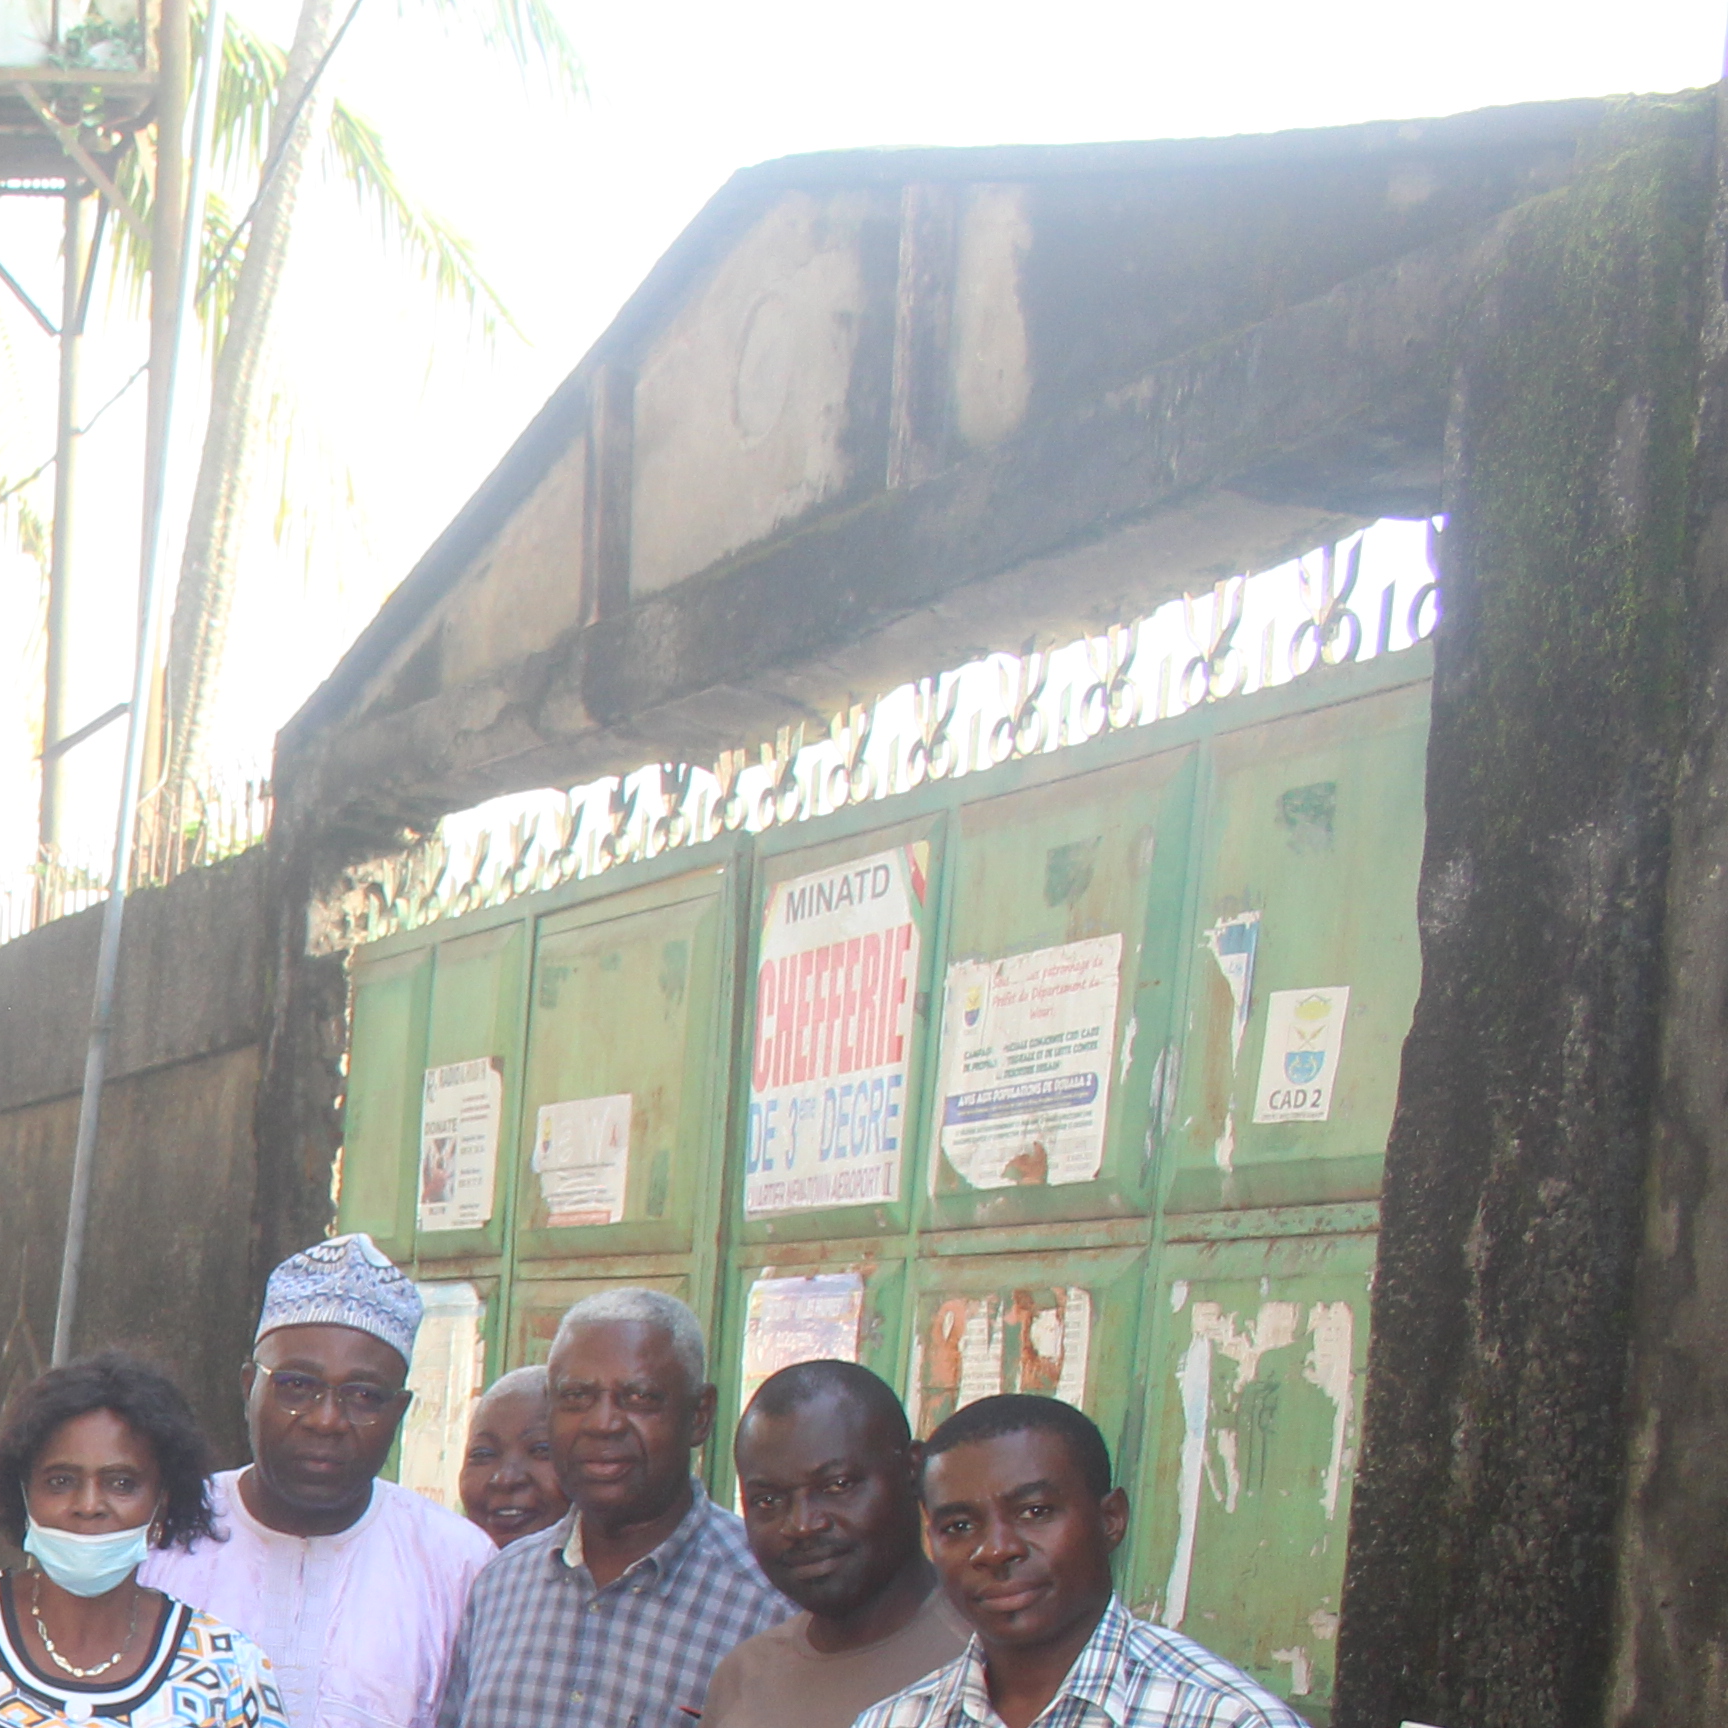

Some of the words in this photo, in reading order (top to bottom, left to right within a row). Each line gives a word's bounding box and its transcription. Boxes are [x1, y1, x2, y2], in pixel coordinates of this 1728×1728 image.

[784, 863, 890, 925] MINATD
[752, 922, 912, 1093] CHEFFERIE
[747, 1098, 778, 1175] DE
[819, 1073, 904, 1162] DEGRE
[1268, 1089, 1307, 1110] CAD
[1309, 1089, 1322, 1108] 2
